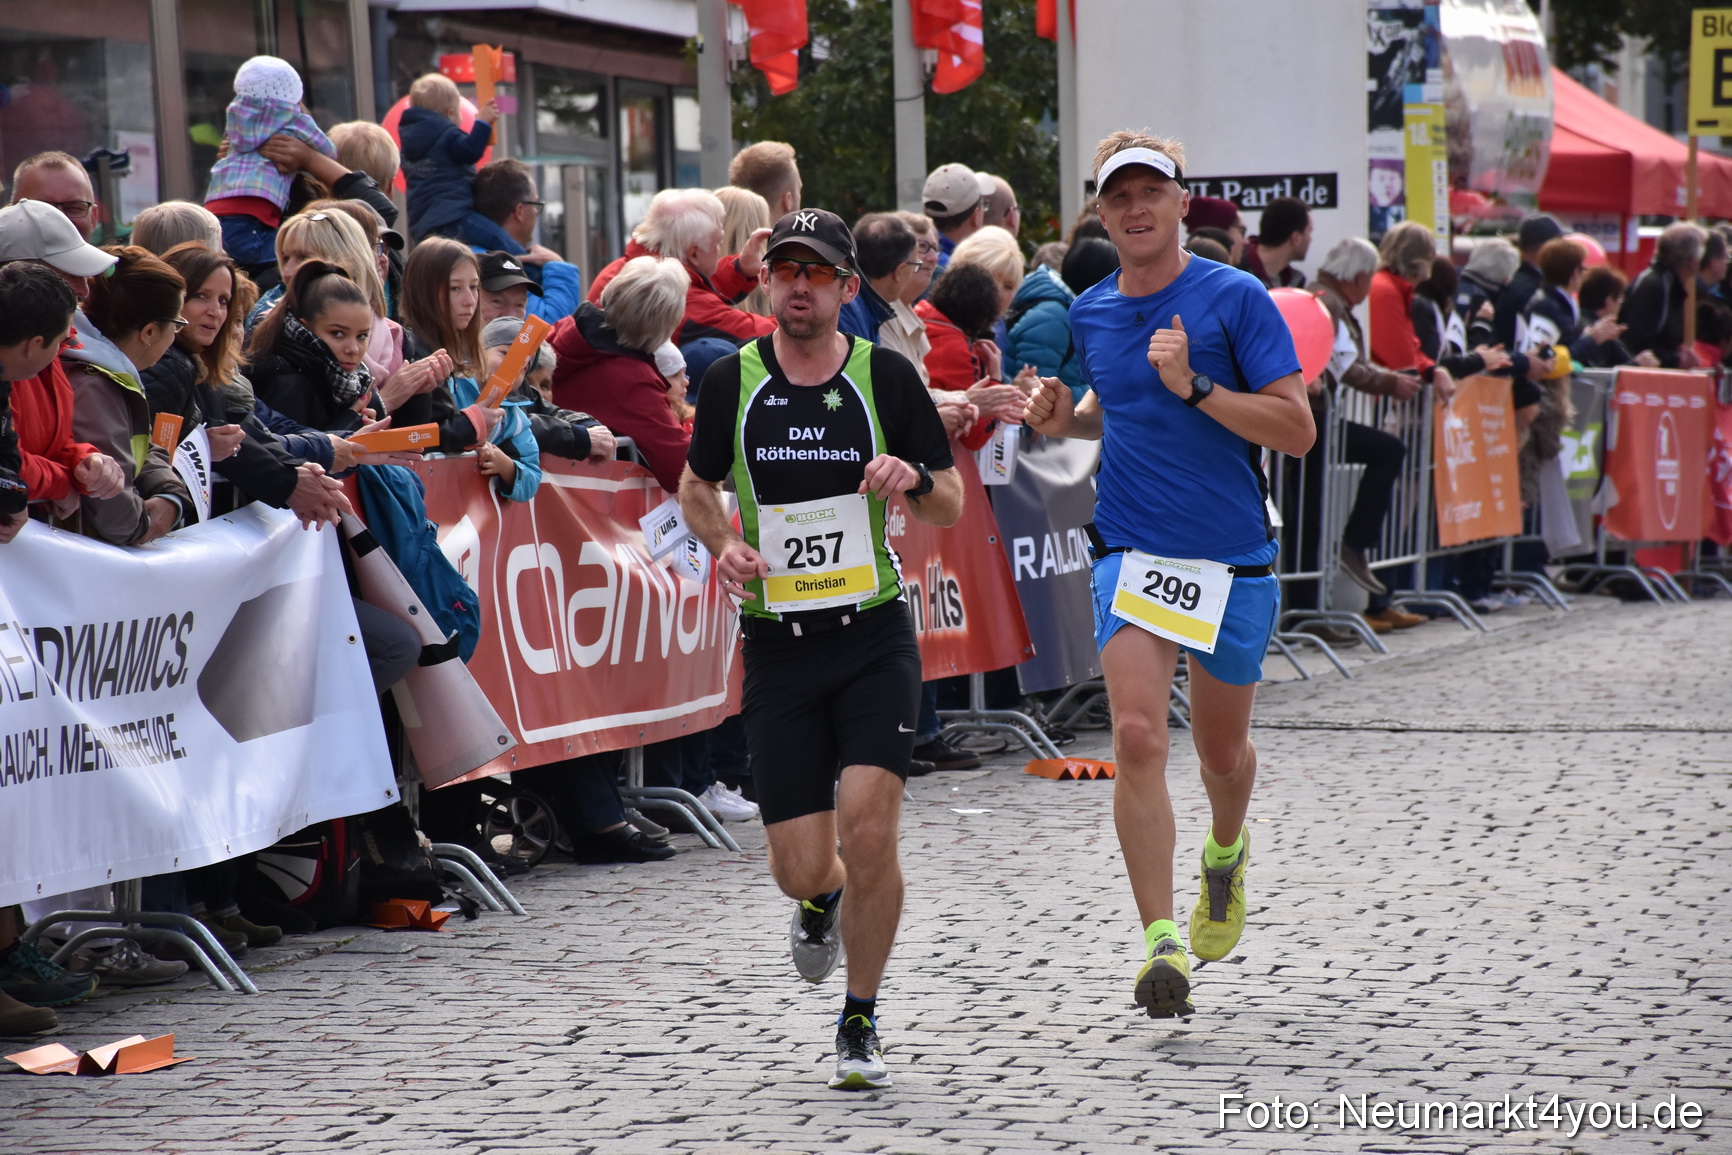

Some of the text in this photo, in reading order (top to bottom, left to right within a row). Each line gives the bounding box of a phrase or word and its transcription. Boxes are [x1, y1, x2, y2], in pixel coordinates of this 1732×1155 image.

[788, 427, 825, 440] DAV
[180, 440, 207, 487] swn
[756, 446, 860, 462] Röthenbach
[796, 508, 836, 523] BOCK
[889, 506, 906, 536] die
[784, 531, 844, 569] 257
[795, 577, 846, 592] Christian
[927, 561, 963, 630] Hits
[1142, 570, 1201, 612] 299
[0, 727, 53, 787] AUCH.
